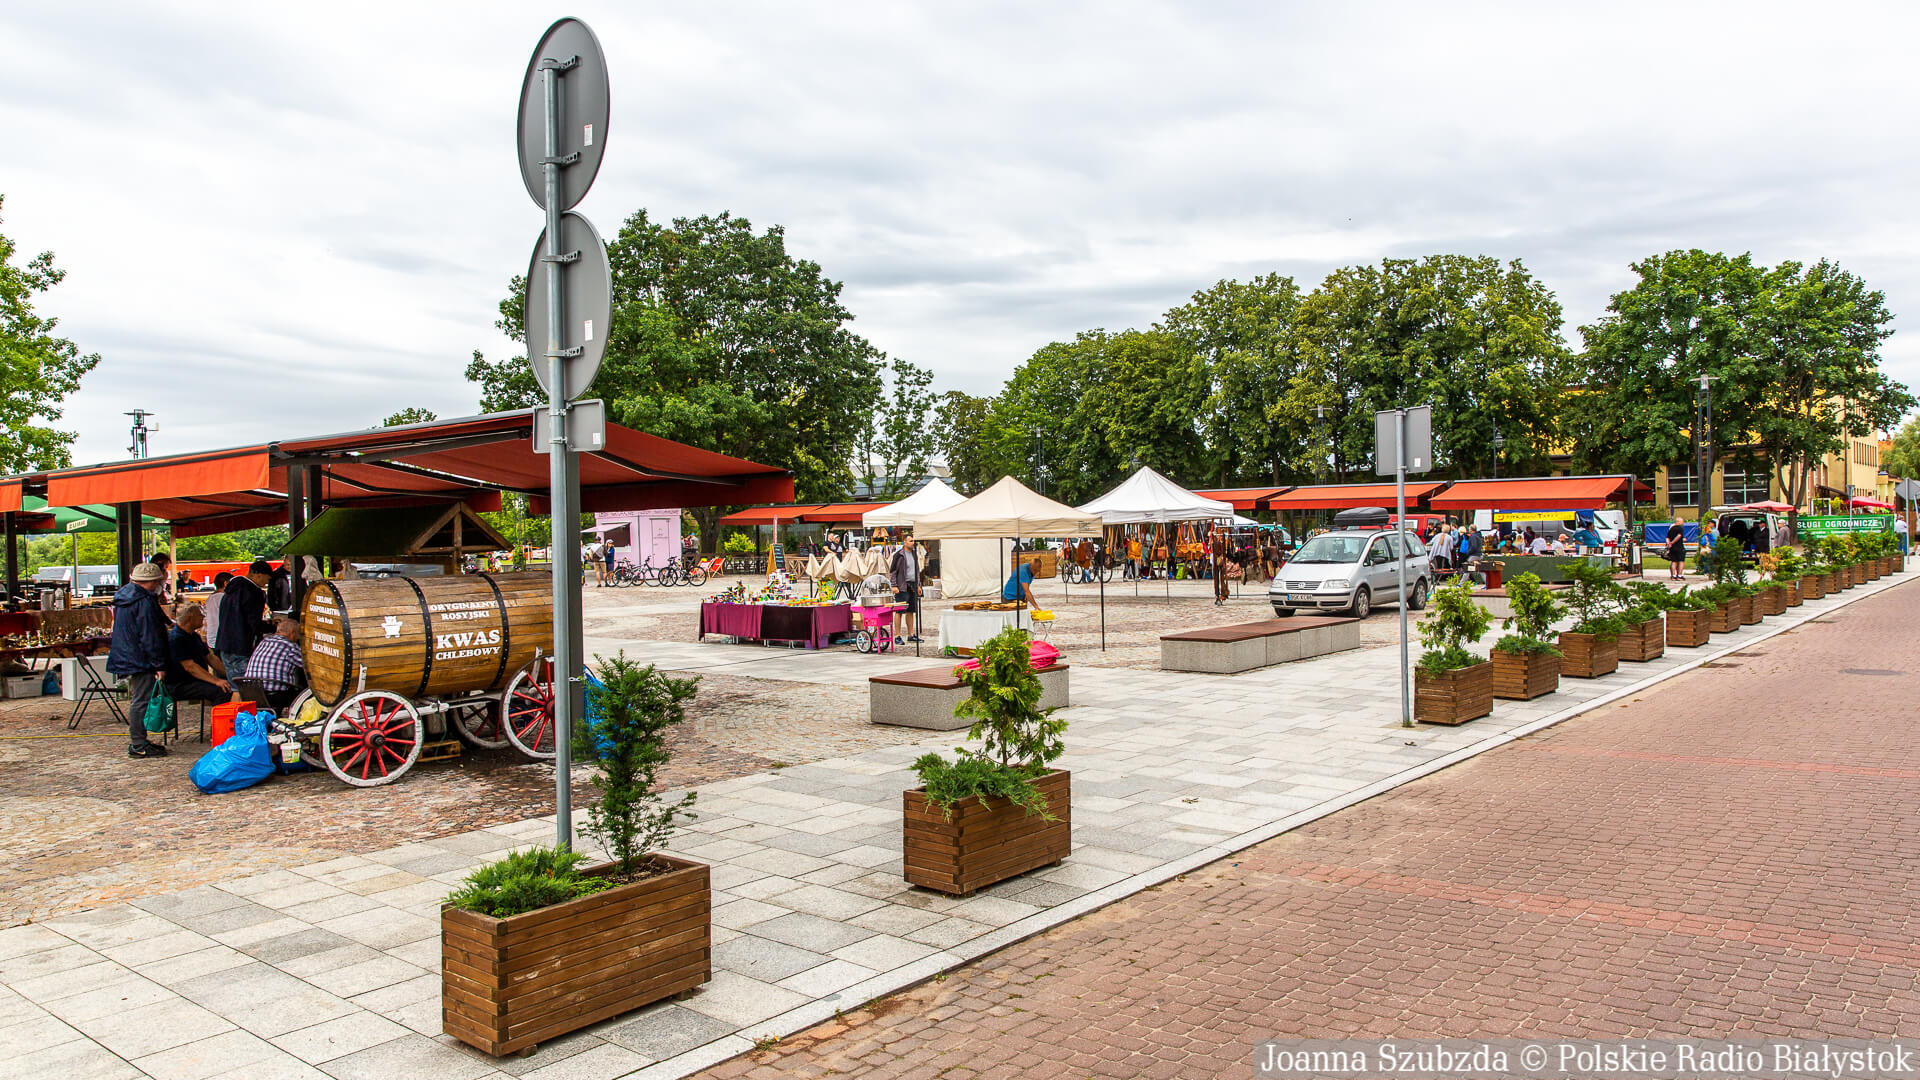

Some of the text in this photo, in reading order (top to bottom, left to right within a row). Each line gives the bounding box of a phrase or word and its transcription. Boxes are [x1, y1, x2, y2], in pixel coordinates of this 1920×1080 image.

[1825, 520, 1878, 528] OGRODNICZE
[430, 601, 496, 611] ORYGINALNY
[441, 610, 490, 621] ROSYJSKI
[436, 629, 501, 650] KWAS
[435, 646, 501, 660] CHLEBOWY
